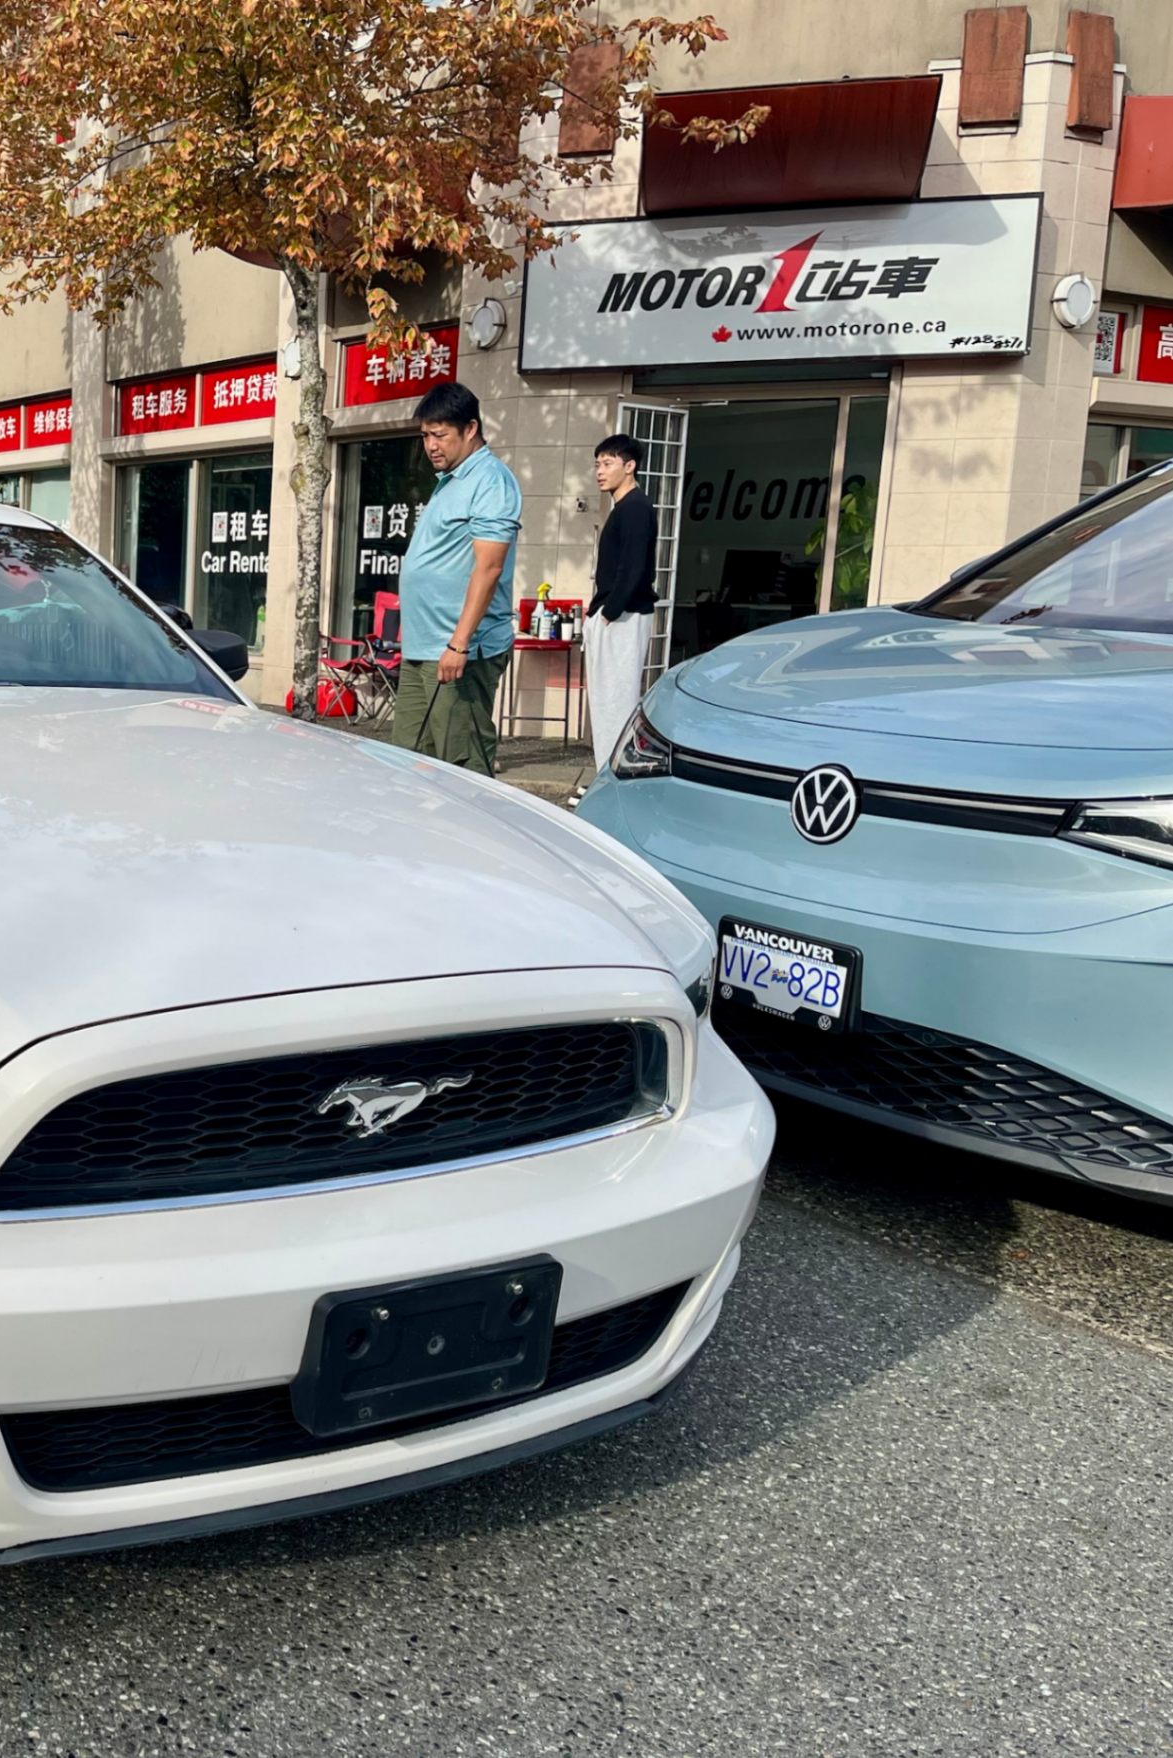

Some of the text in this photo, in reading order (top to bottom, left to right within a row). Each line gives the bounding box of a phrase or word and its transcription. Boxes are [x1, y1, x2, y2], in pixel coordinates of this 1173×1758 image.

[736, 320, 947, 341] www.motorone.ca
[132, 387, 187, 420] 租车服务
[213, 371, 277, 409] 抵押贷款
[230, 509, 268, 542] 租车
[201, 550, 226, 573] Car
[734, 923, 834, 963] VANCOUVER
[723, 942, 771, 989] VV2
[787, 961, 841, 1008] 82B
